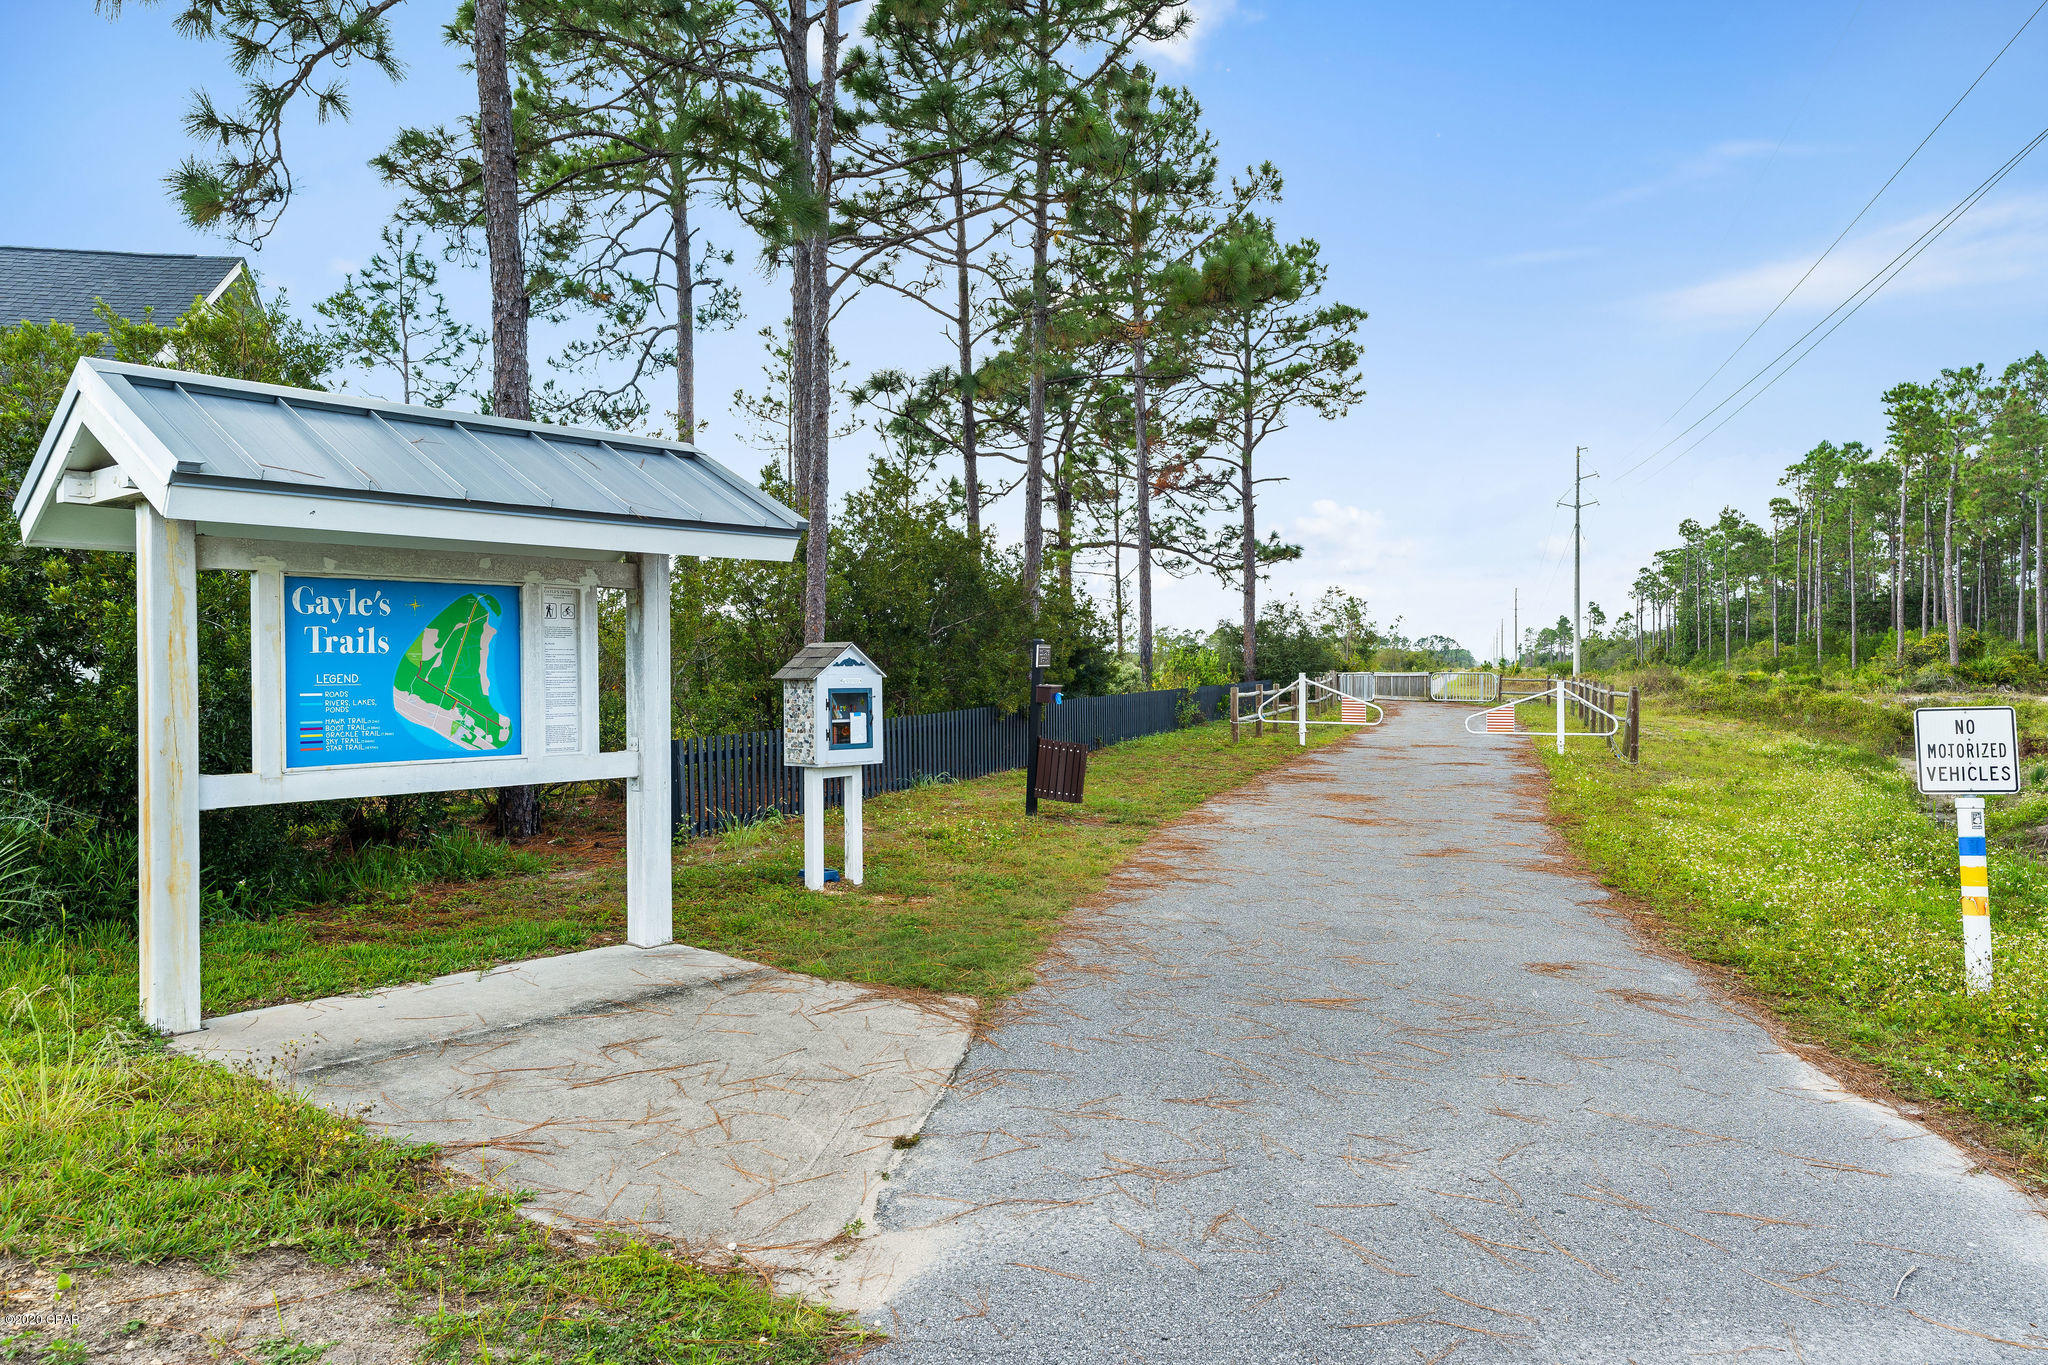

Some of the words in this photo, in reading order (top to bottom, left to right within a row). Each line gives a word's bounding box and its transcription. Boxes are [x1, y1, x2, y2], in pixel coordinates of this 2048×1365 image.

[292, 585, 391, 623] Gayle's
[304, 626, 390, 654] Trails
[316, 674, 359, 683] LEGEND
[1955, 719, 1975, 735] NO
[1927, 743, 2007, 758] MOTORIZED
[1926, 766, 2011, 781] VEHICLES
